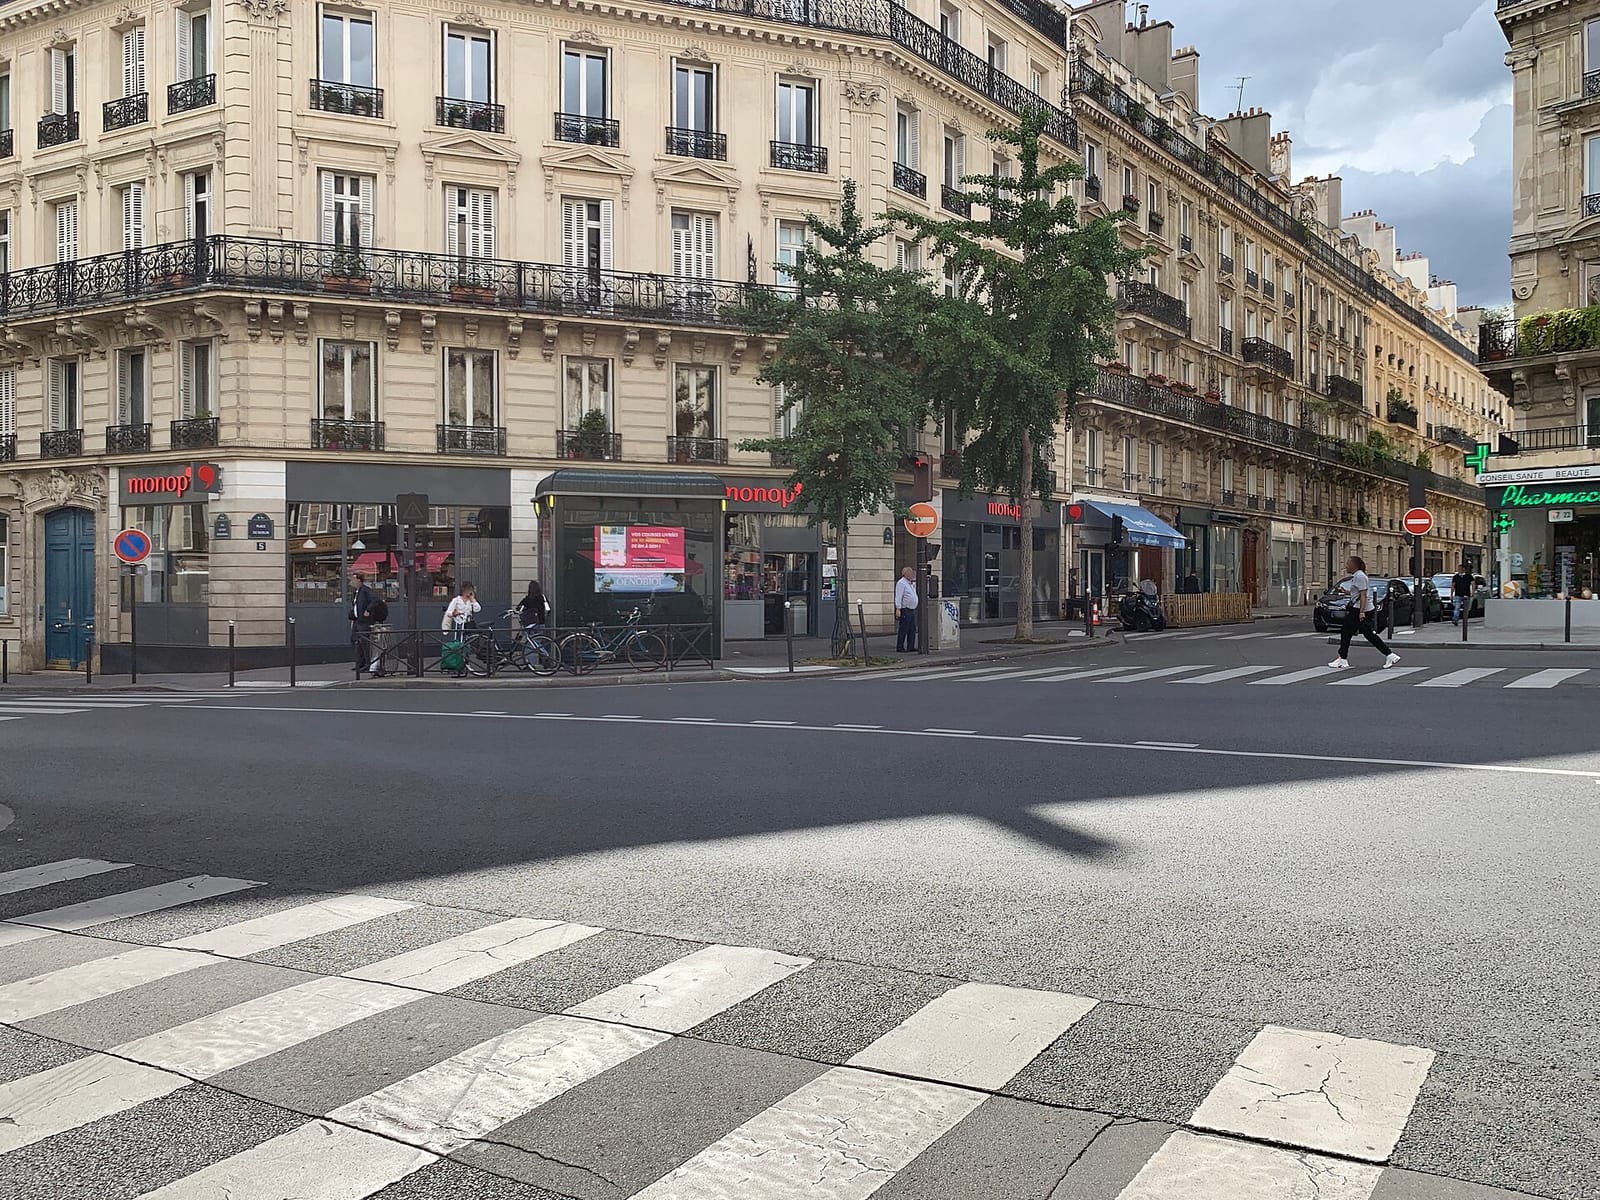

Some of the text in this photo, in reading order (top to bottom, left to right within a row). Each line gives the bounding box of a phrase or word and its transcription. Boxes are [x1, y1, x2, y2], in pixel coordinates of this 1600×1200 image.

[128, 467, 192, 498] monop'
[1479, 469, 1590, 482] CONSEIL SANTE BEAUTE
[1501, 485, 1600, 507] Pharmac
